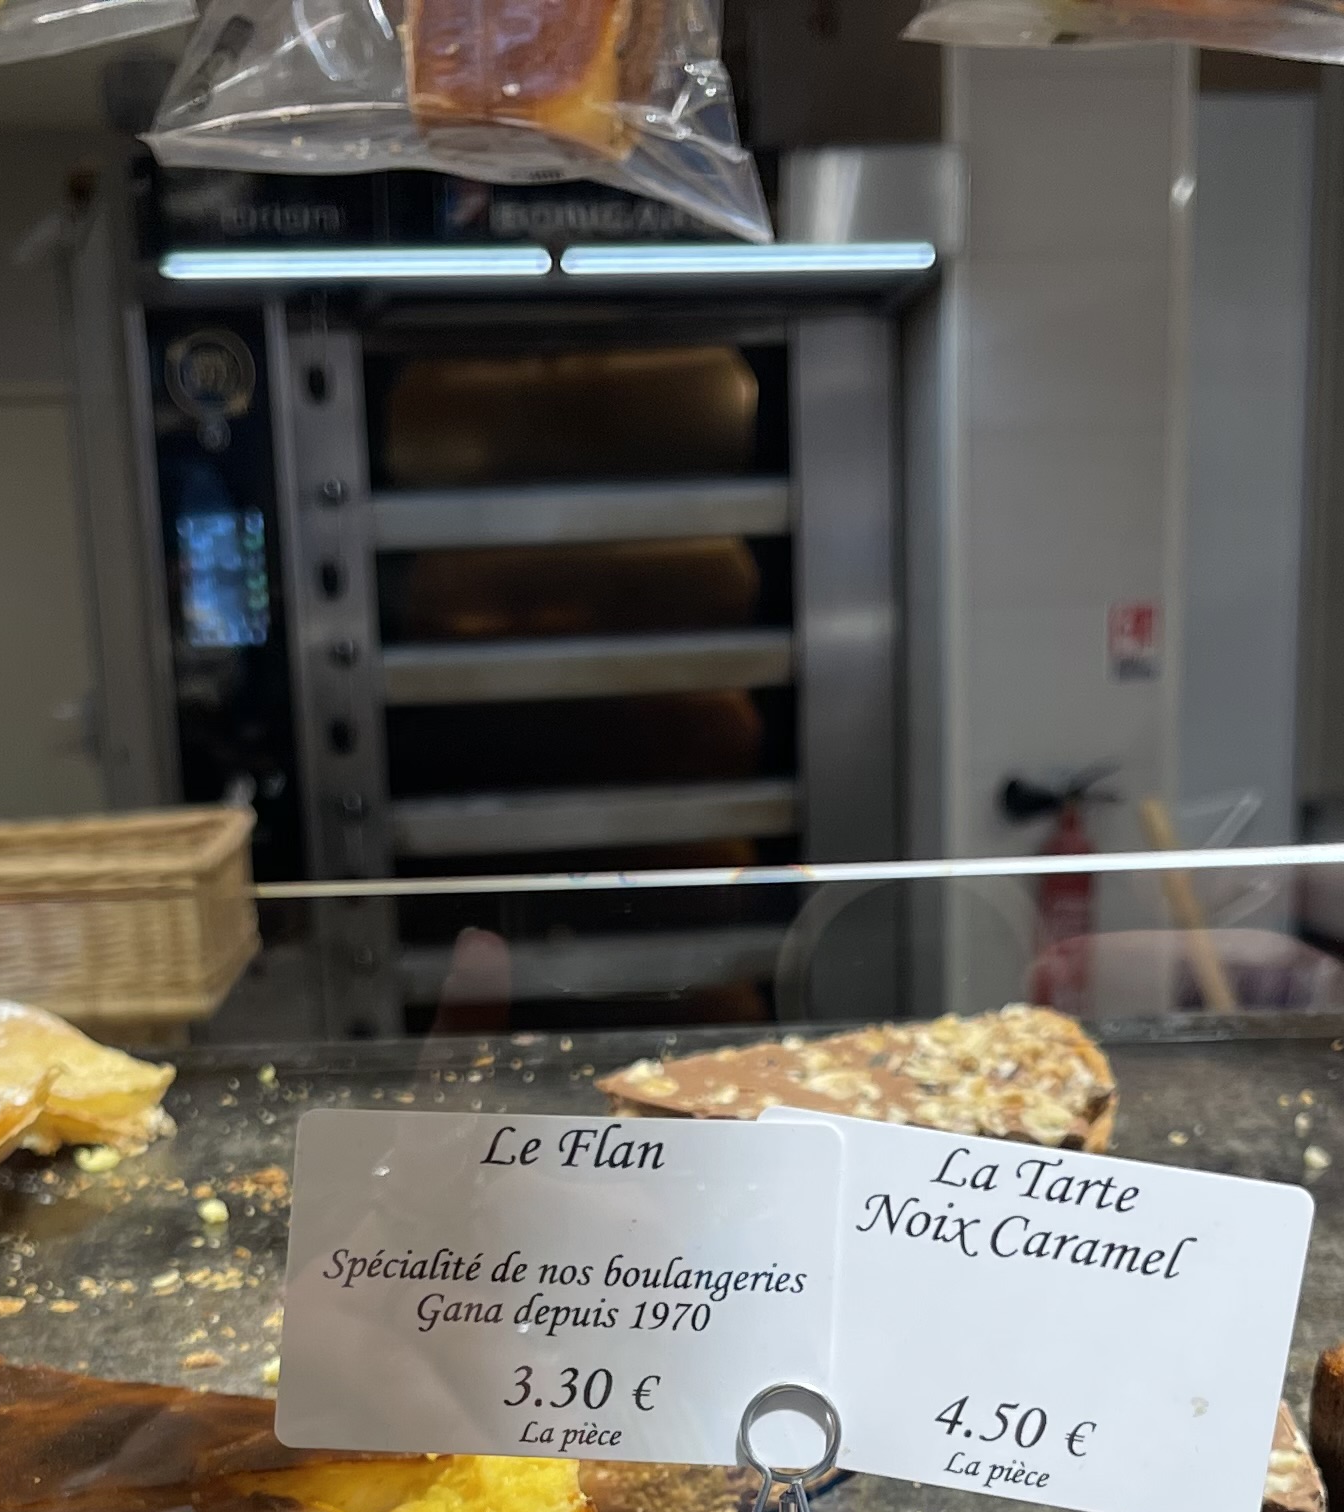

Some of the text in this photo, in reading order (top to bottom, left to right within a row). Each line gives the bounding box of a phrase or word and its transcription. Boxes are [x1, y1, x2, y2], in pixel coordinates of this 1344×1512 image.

[479, 1123, 665, 1170] Le Flan
[930, 1147, 1140, 1213] La Tarte
[855, 1194, 1198, 1279] Noix Caramel
[322, 1247, 807, 1302] Spécialité de nos boulangeries
[417, 1293, 712, 1337] Gana depuis 1970
[503, 1365, 662, 1412] 3.30 €
[518, 1421, 623, 1453] La pièce
[934, 1395, 1097, 1457] 4.50 €
[943, 1451, 1050, 1488] La pièce
